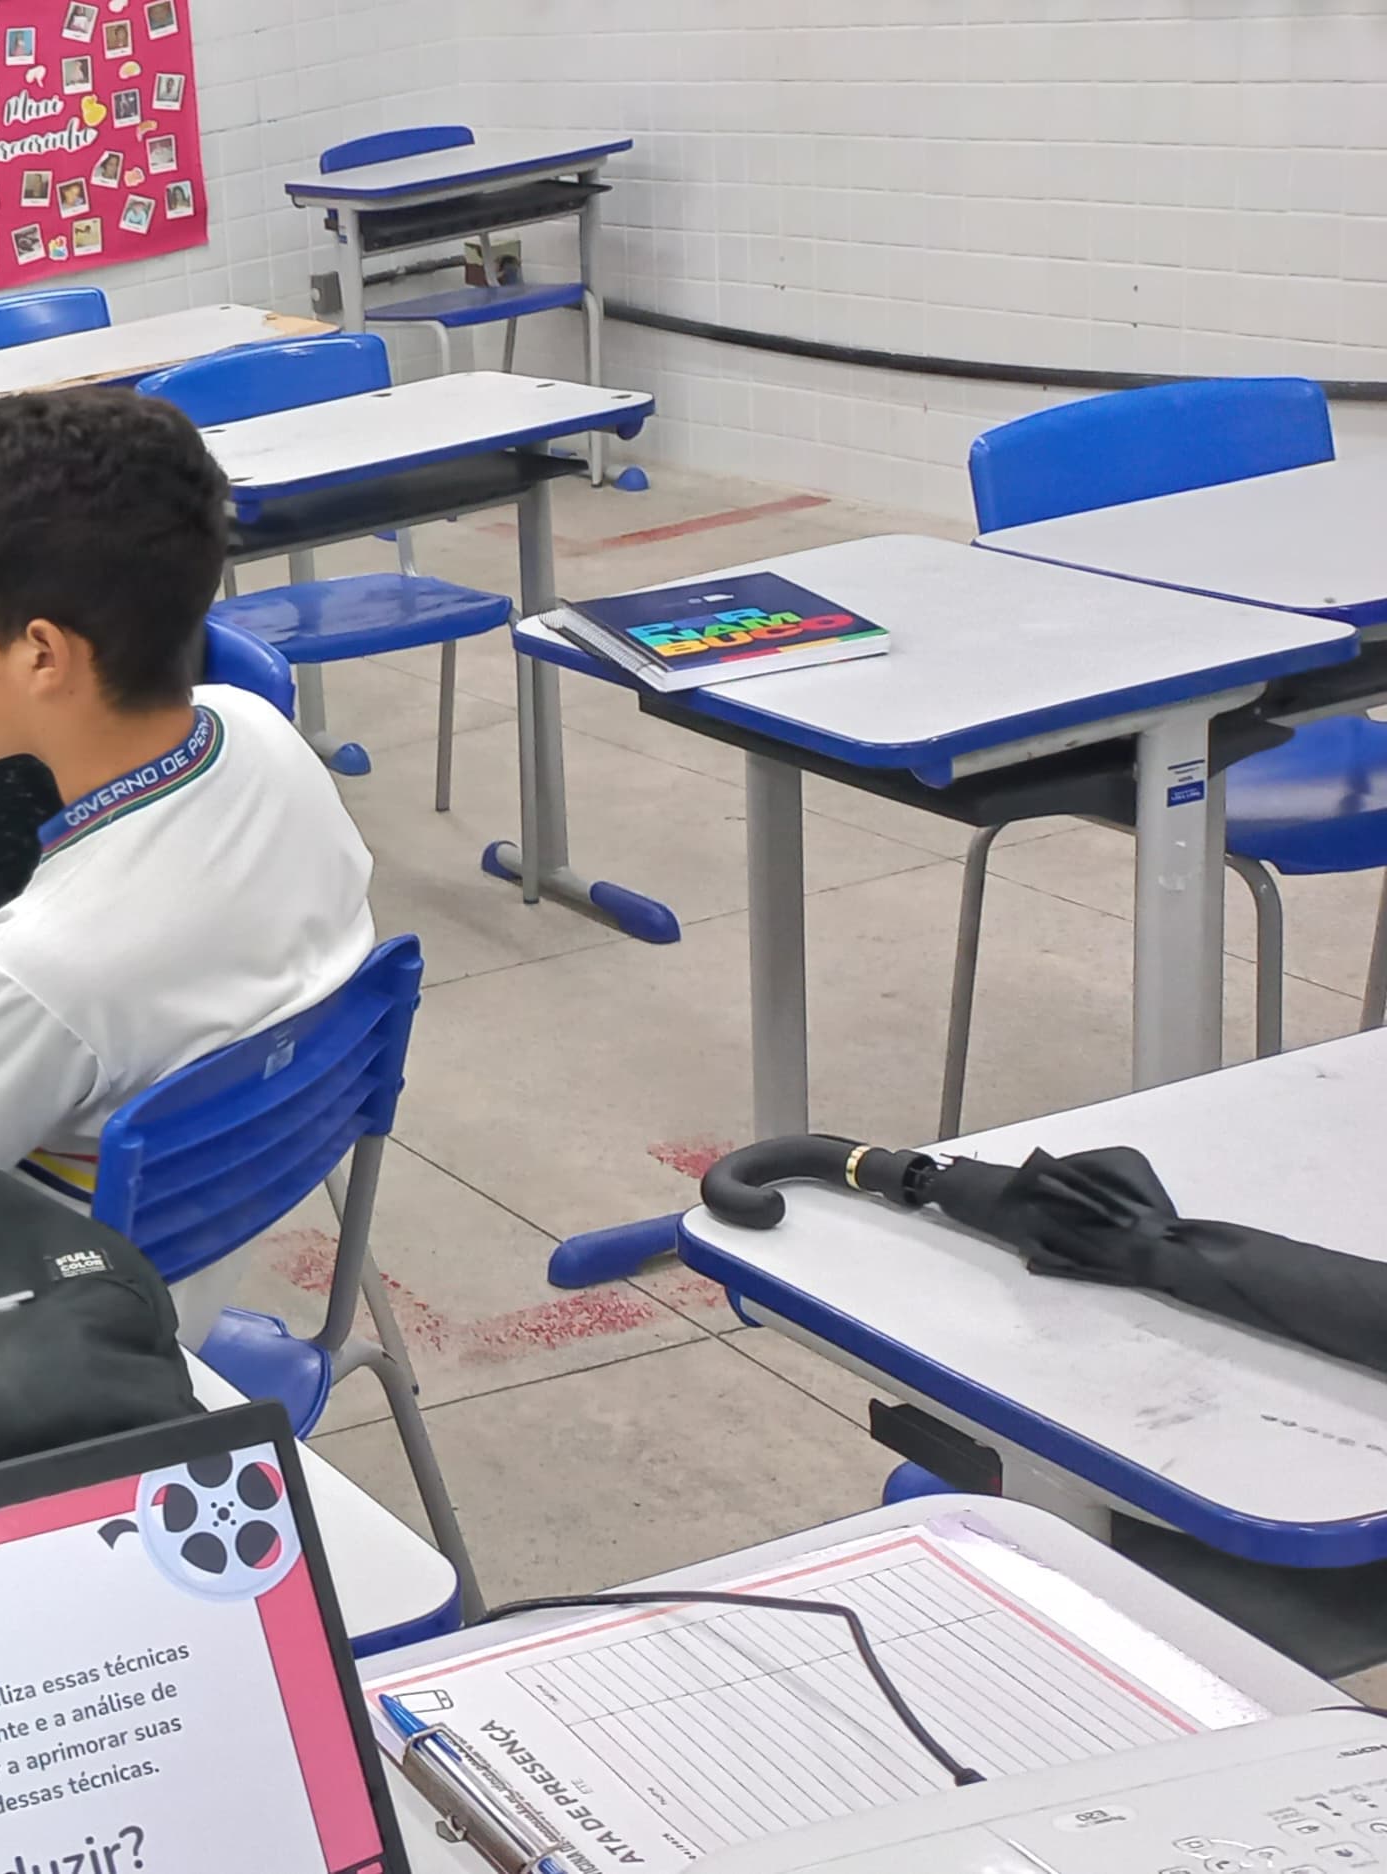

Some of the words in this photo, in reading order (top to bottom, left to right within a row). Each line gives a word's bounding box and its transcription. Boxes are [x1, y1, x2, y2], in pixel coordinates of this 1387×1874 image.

[64, 767, 159, 826] GOVERNO
[161, 748, 189, 775] DE
[56, 1251, 102, 1266] FULL
[61, 1259, 104, 1272] COLOR
[42, 1667, 100, 1693] essas
[103, 1644, 189, 1677] técnicas
[34, 1717, 48, 1731] e
[52, 1712, 66, 1727] a
[71, 1692, 146, 1722] análise
[150, 1681, 177, 1701] de
[7, 1760, 20, 1775] a
[25, 1730, 128, 1771] aprimorar
[134, 1717, 182, 1741] suas
[480, 1720, 574, 1806] PRESENÇA
[66, 1760, 159, 1794] técnicas.
[566, 1800, 606, 1832] DE
[596, 1830, 645, 1863] ATA
